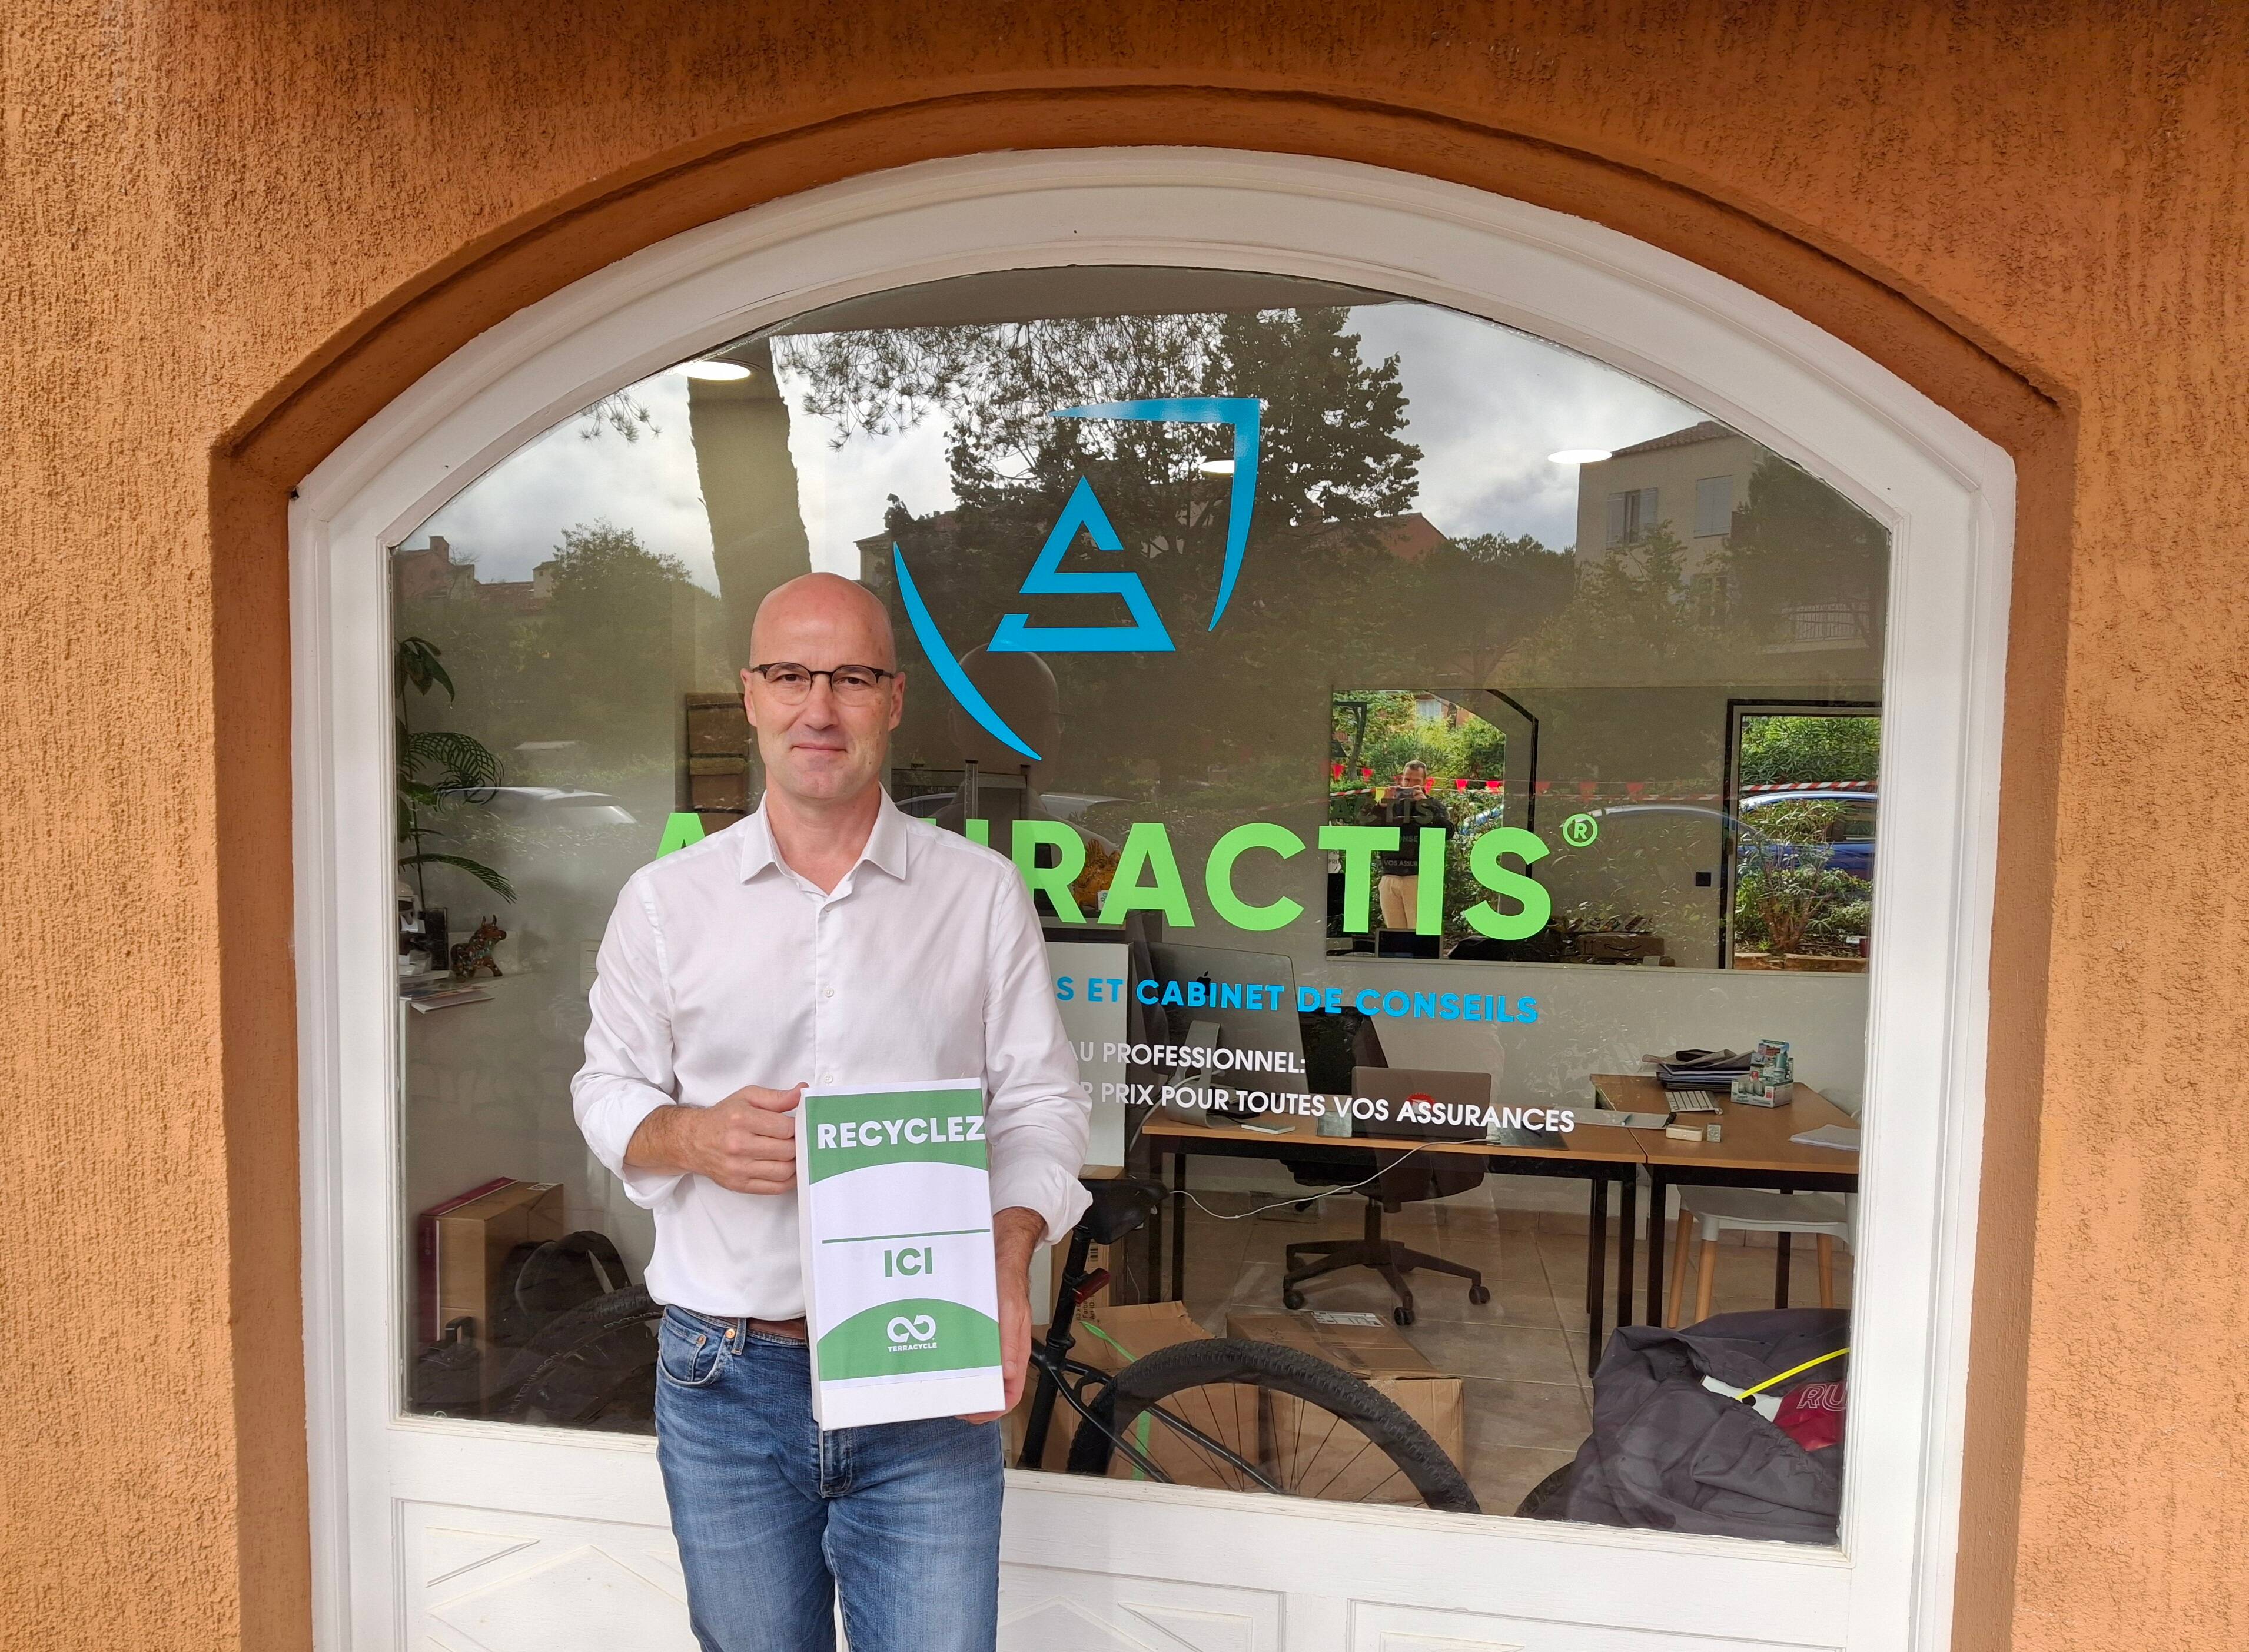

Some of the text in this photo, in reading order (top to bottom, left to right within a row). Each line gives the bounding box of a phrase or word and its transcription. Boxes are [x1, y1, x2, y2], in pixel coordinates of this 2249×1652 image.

[656, 812, 1551, 940] RACTIS
[1088, 978, 1125, 1003] ET
[1136, 979, 1285, 1011] CABINET
[1297, 986, 1343, 1014] DE
[1356, 989, 1539, 1023] CONSEILS
[1103, 1042, 1305, 1074] PROFESSIONNEL:
[1101, 1082, 1154, 1106] PRIX
[1161, 1086, 1230, 1111] POUR
[1236, 1090, 1326, 1117] TOUTES
[1333, 1096, 1390, 1121] VOS
[1396, 1101, 1576, 1133] ASSURANCES
[817, 1115, 985, 1149] RECYCLEZ
[884, 1247, 933, 1277] ICI
[888, 1342, 938, 1352] TERRACYCLE
